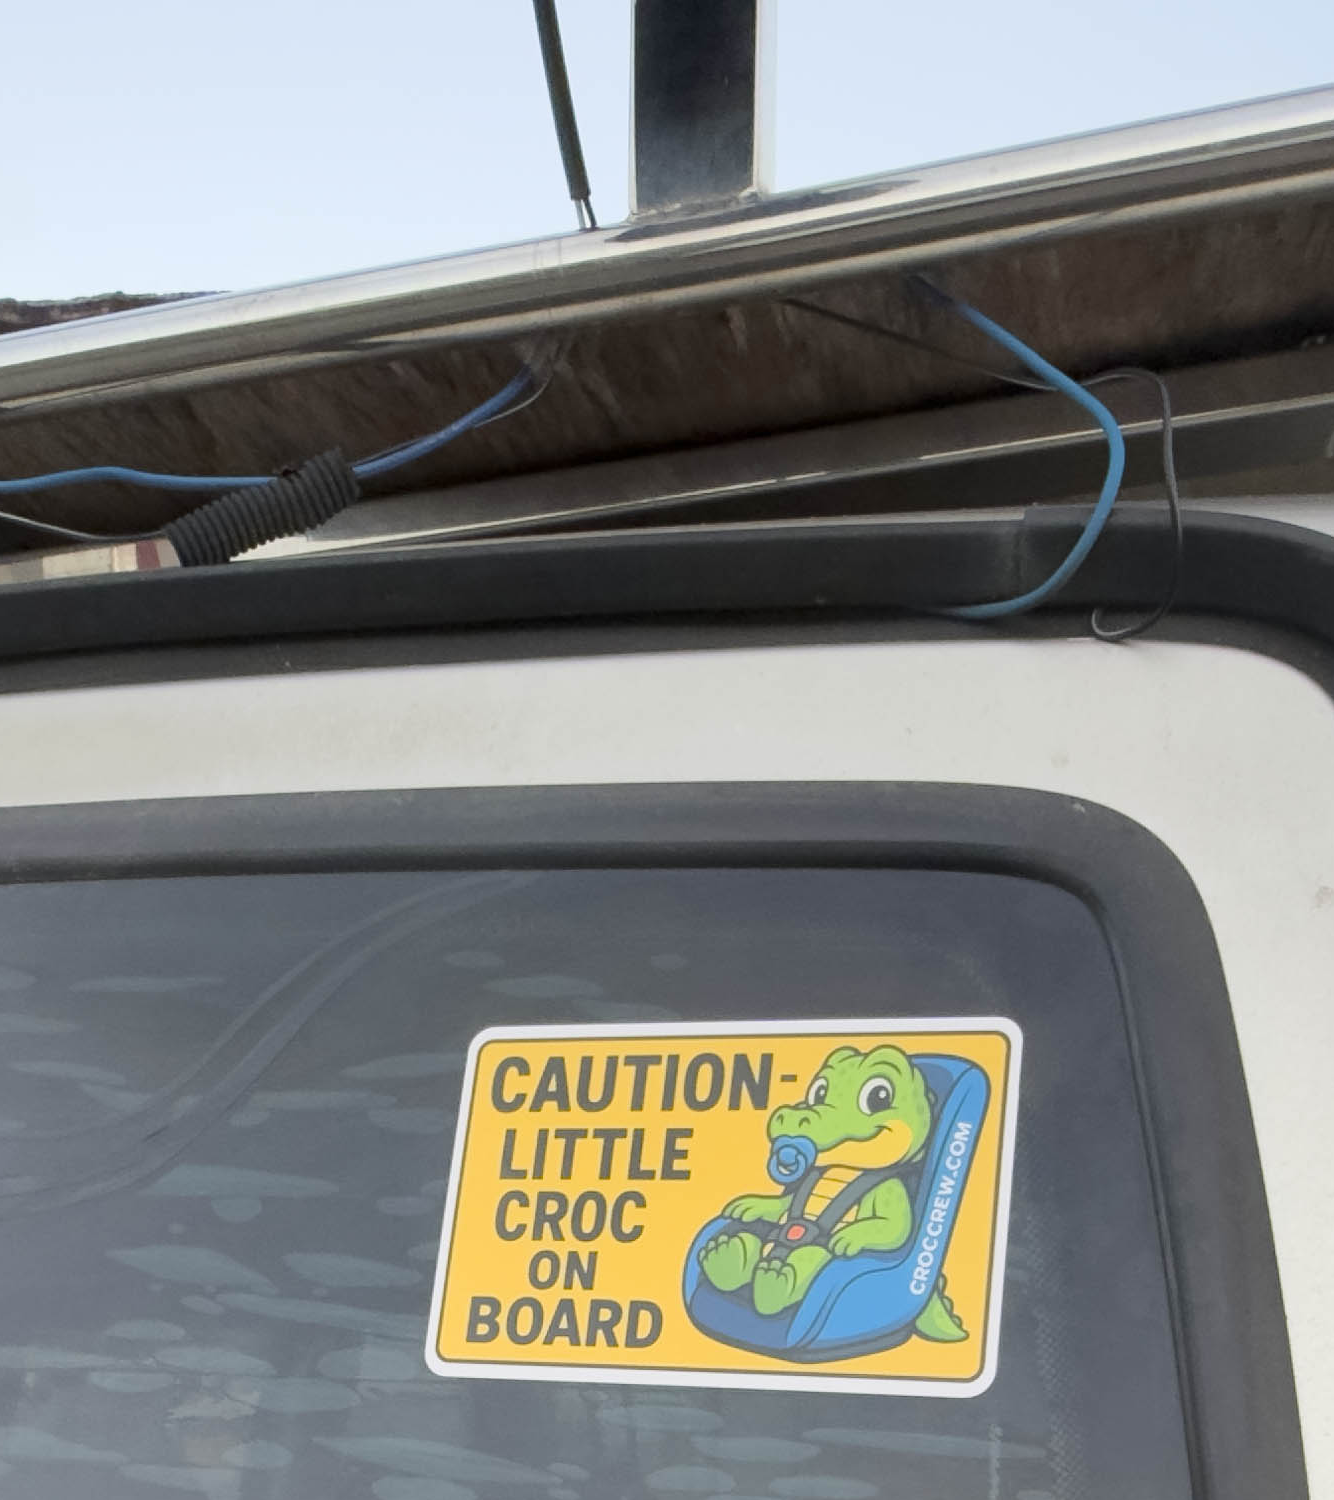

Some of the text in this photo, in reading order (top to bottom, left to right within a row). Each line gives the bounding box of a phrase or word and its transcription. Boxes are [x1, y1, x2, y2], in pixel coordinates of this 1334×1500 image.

[490, 1052, 798, 1113] CAUTION-
[498, 1127, 695, 1182] LITTLE
[494, 1190, 648, 1243] CROC
[909, 1121, 973, 1296] CROCCREW.COM
[528, 1249, 600, 1291] ON
[465, 1295, 664, 1349] BOARD
